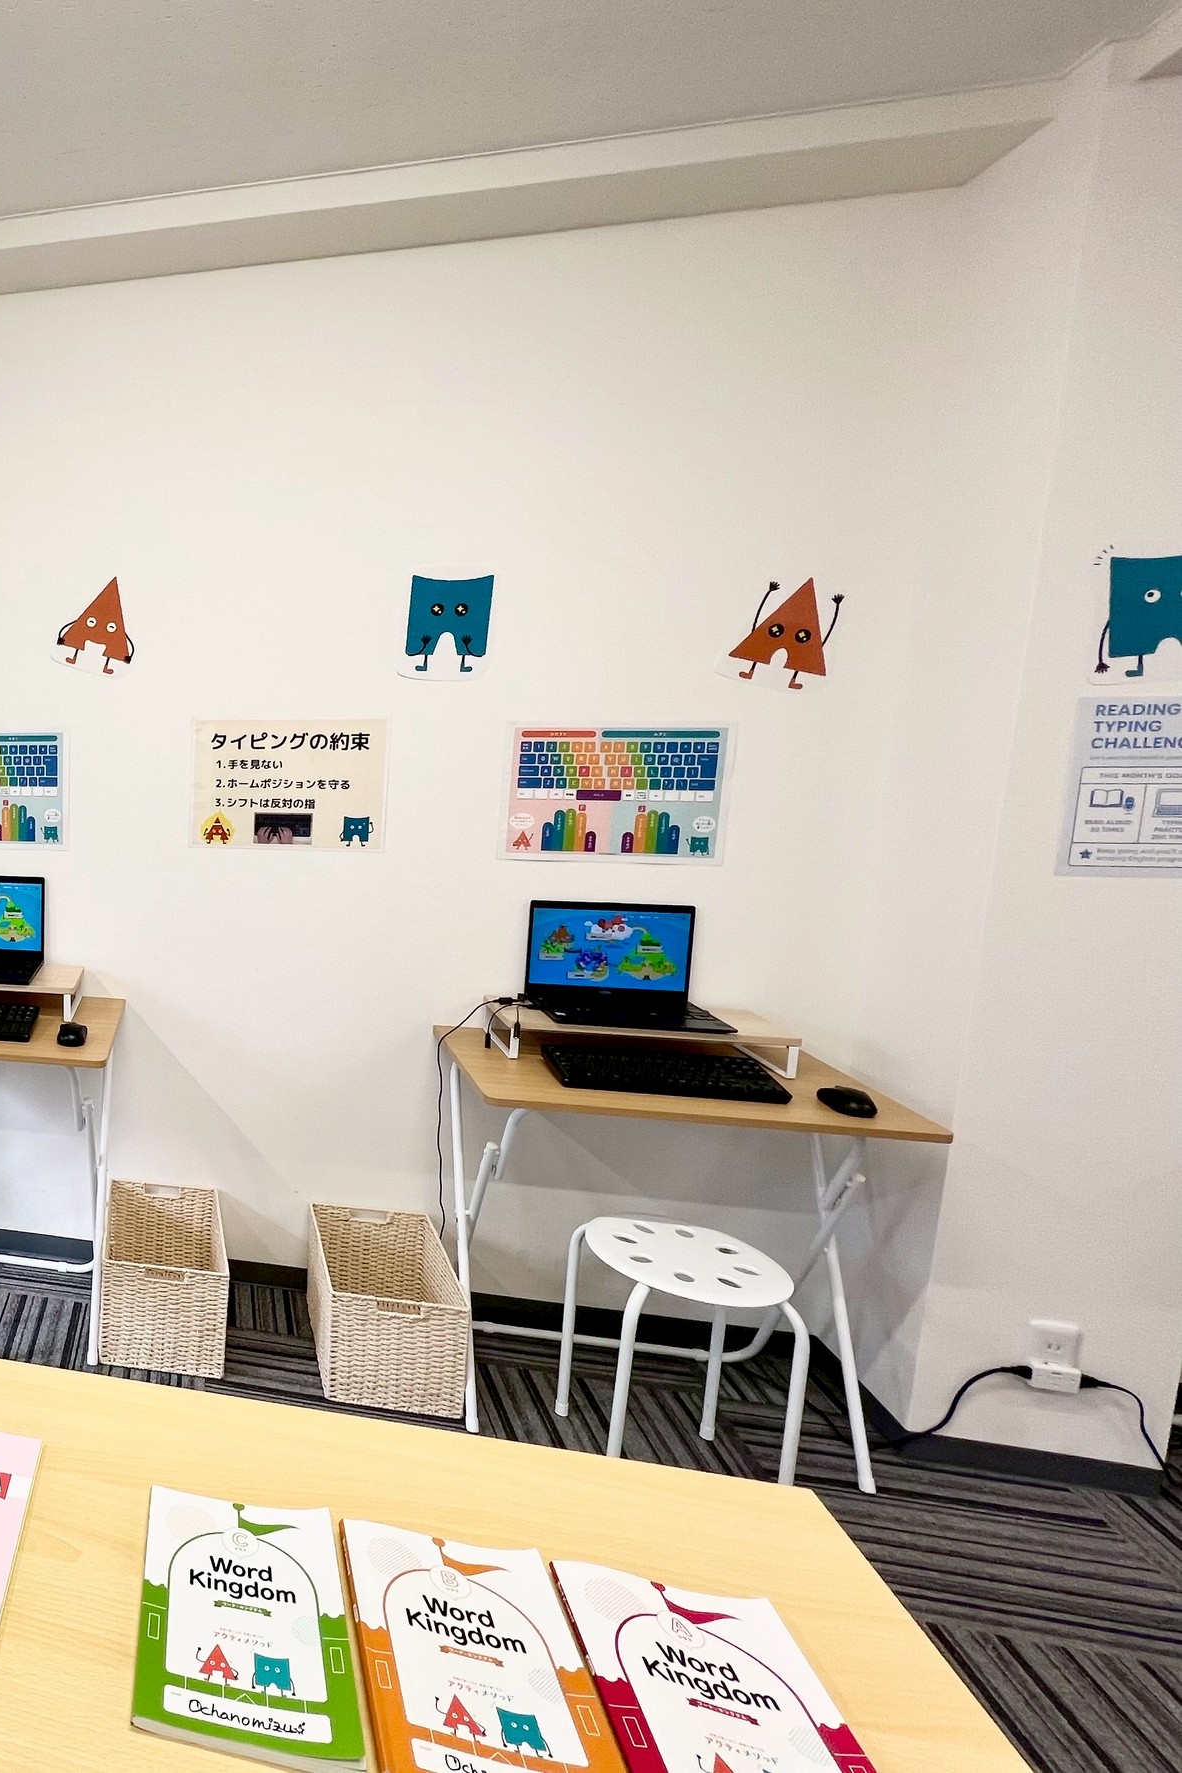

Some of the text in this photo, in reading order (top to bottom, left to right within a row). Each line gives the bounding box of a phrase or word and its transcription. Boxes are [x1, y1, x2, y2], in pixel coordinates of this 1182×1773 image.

[1095, 703, 1181, 716] READING
[211, 732, 370, 751] タイピングの約束
[1093, 720, 1162, 733] TYPING
[209, 1555, 272, 1582] Word
[189, 1568, 297, 1604] Kingdom
[422, 1595, 495, 1628] Word
[406, 1608, 526, 1654] Kingdom
[655, 1641, 740, 1683] Word
[642, 1656, 782, 1712] Kingdom
